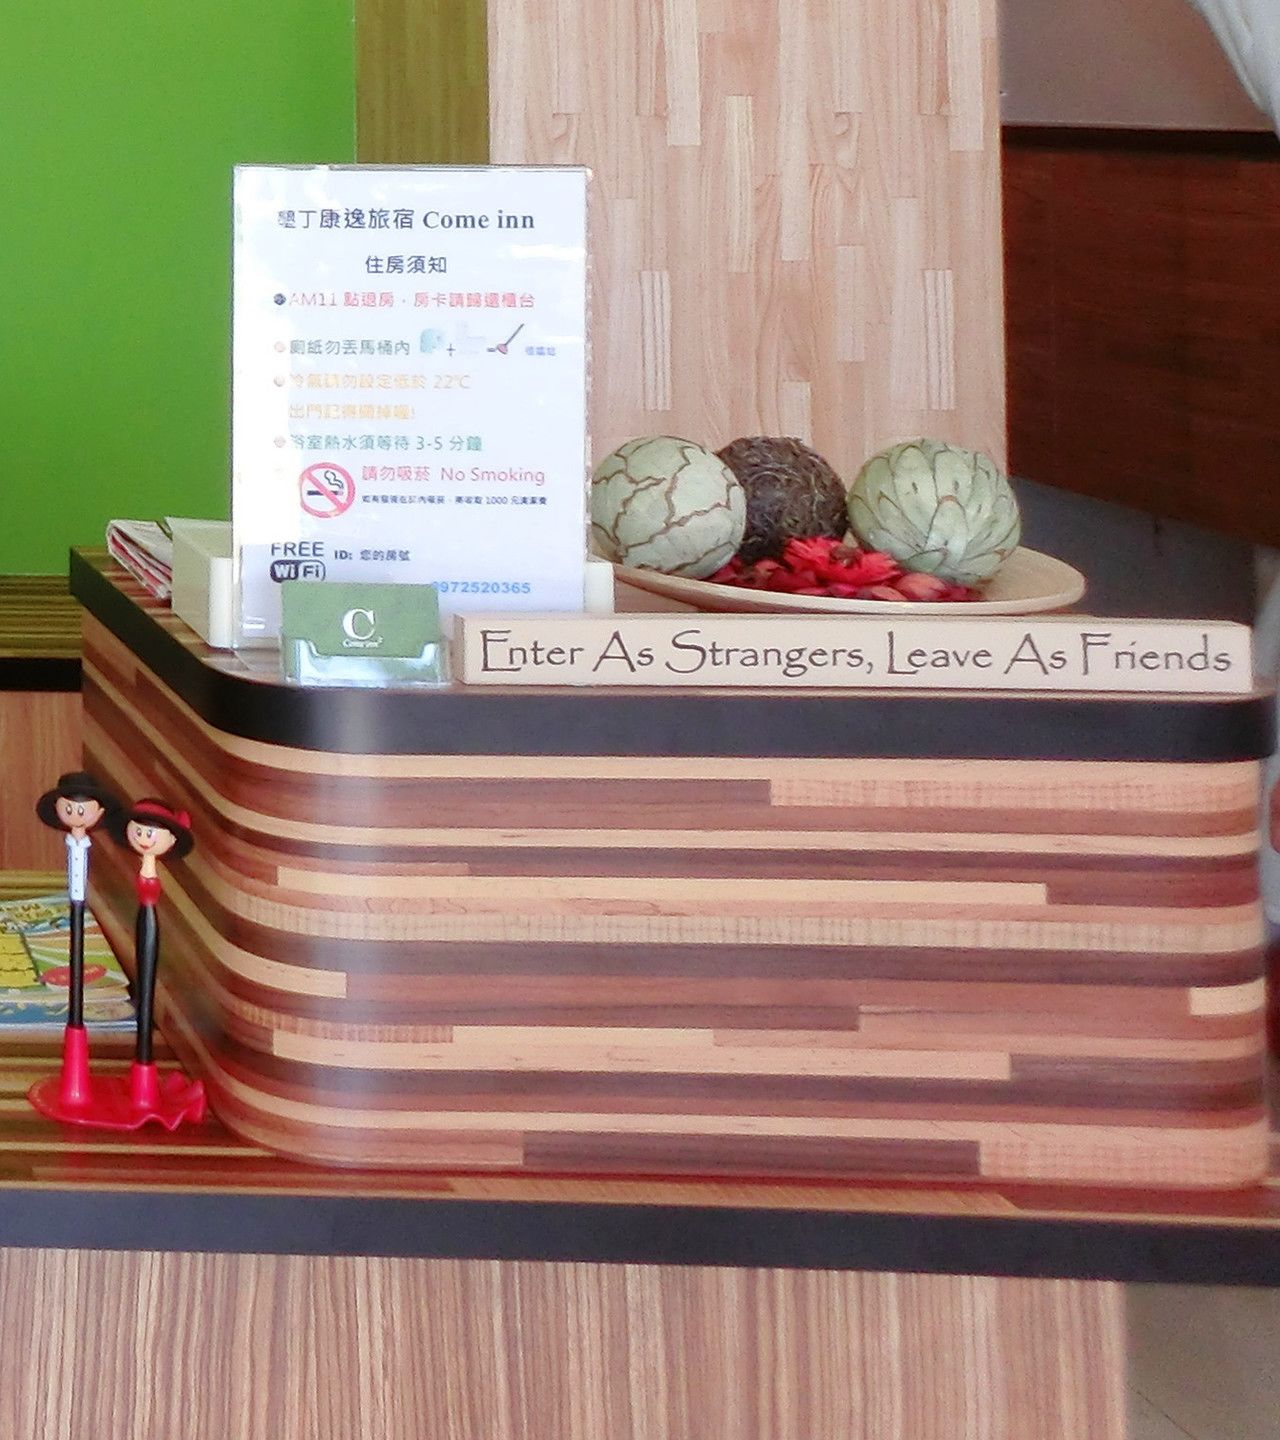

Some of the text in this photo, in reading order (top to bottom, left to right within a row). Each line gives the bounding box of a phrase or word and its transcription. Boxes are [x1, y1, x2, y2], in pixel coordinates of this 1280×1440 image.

[422, 210, 490, 230] Come
[497, 209, 536, 229] inn
[365, 255, 448, 275] 住房須知
[415, 436, 444, 451] 3-5
[448, 435, 483, 452] 分鐘
[361, 464, 546, 487] 請勿吸菸 No Smoking
[270, 540, 325, 558] FREE
[333, 549, 353, 561] ID:
[479, 628, 1233, 679] Enter As Strangers, Leave As Friends
